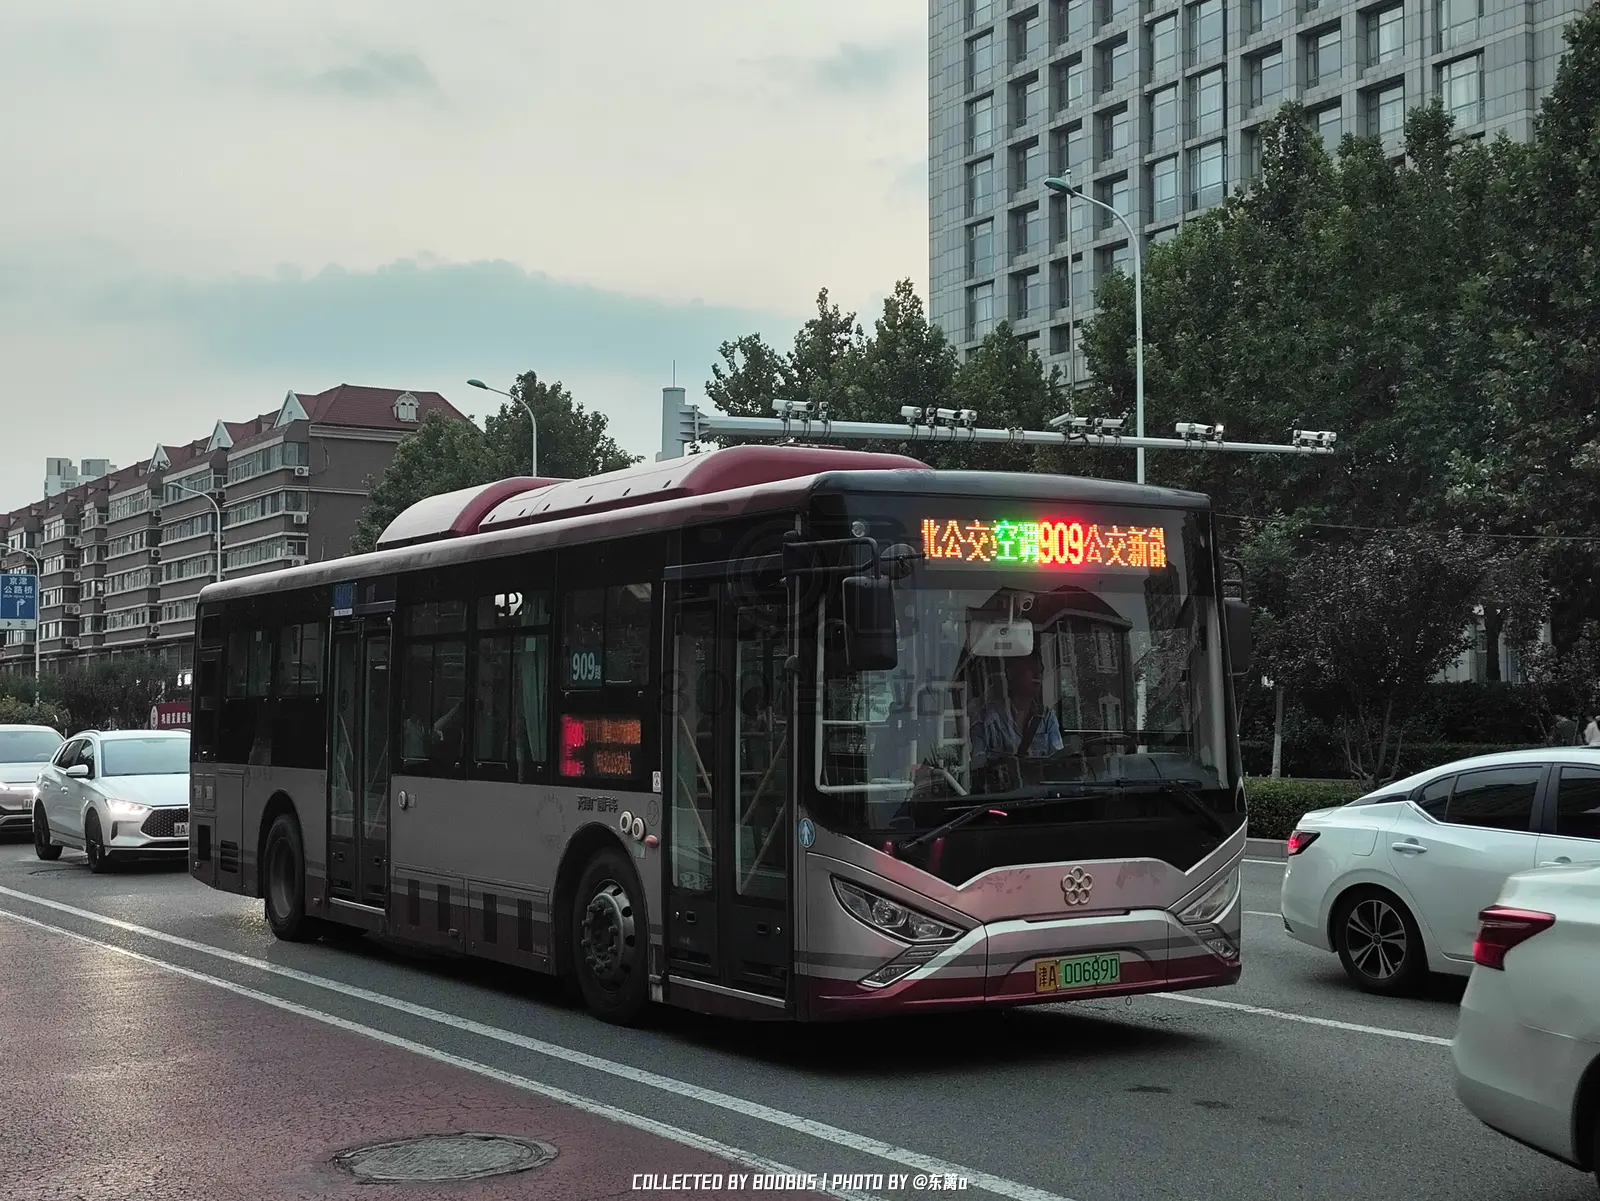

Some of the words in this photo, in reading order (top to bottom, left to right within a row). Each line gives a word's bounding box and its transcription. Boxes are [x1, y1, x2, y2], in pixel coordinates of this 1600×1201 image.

[921, 519, 998, 561] 北公交
[1039, 521, 1084, 564] 909
[3, 585, 33, 594] 公路桥
[9, 576, 28, 586] 京津
[1038, 958, 1118, 988] 津A00689D
